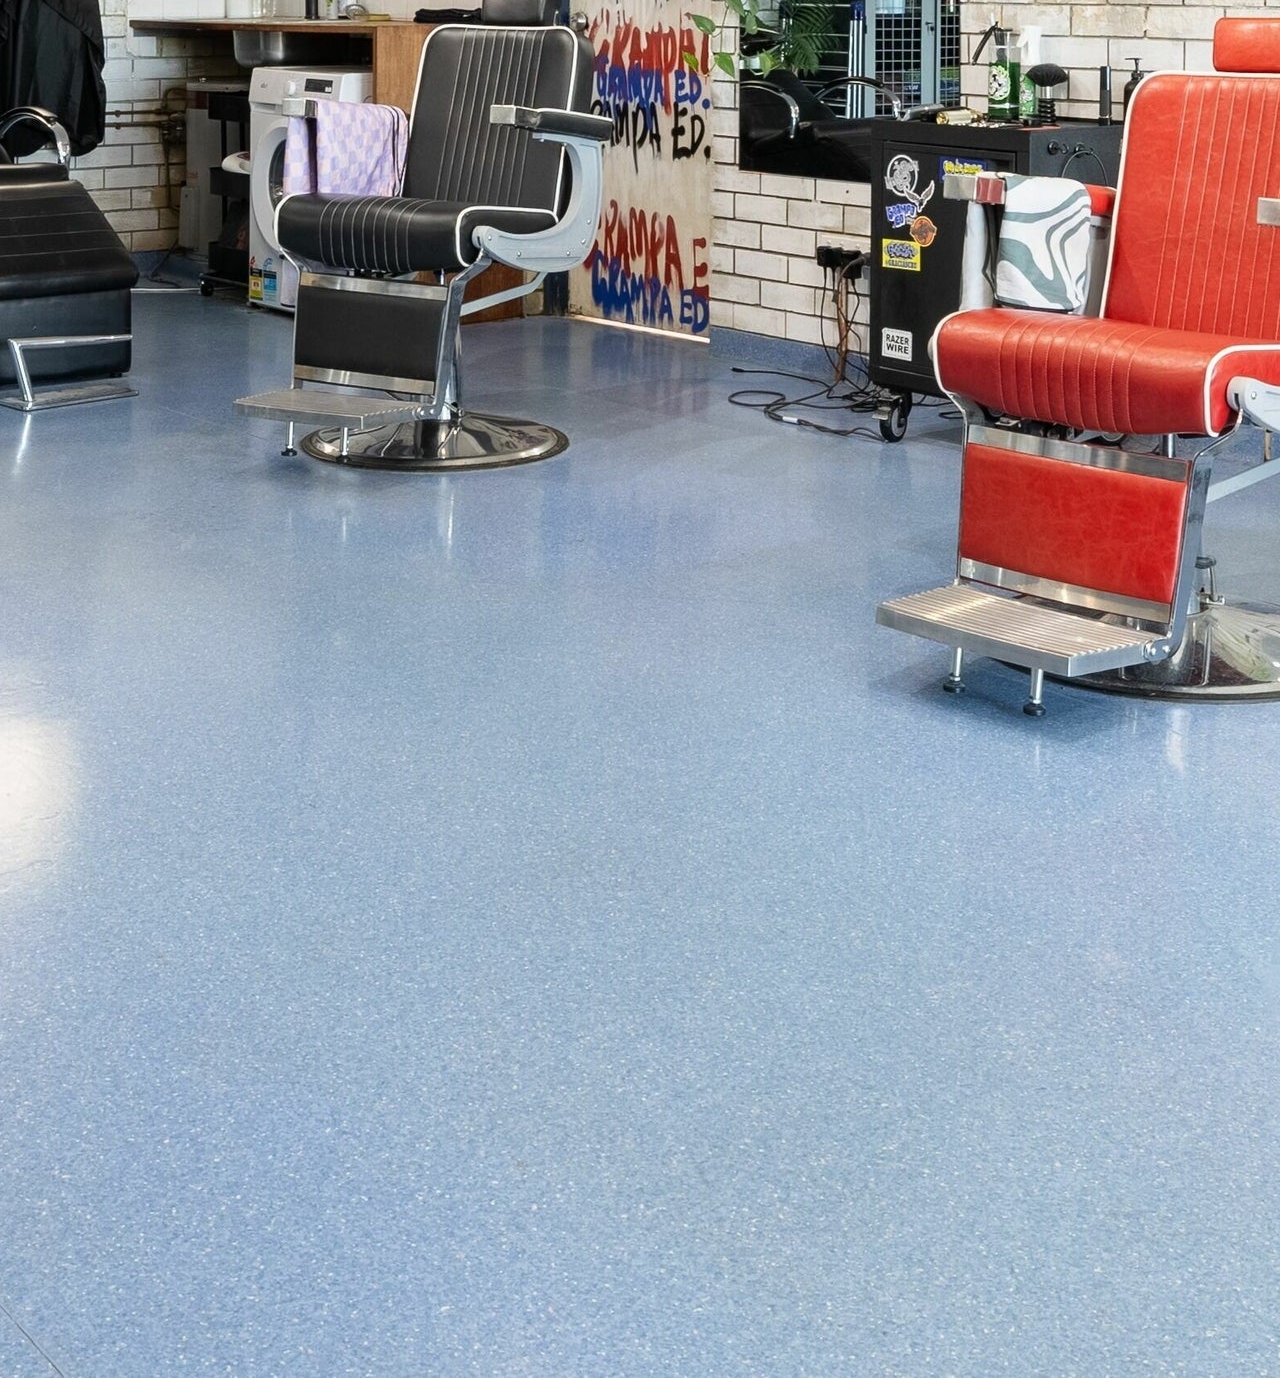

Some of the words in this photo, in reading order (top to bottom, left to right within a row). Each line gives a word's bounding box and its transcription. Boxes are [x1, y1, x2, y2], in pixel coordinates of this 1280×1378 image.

[592, 249, 674, 324] GRAMPA
[680, 288, 710, 333] ED
[885, 333, 910, 345] RAZER
[885, 343, 910, 355] WIRE
